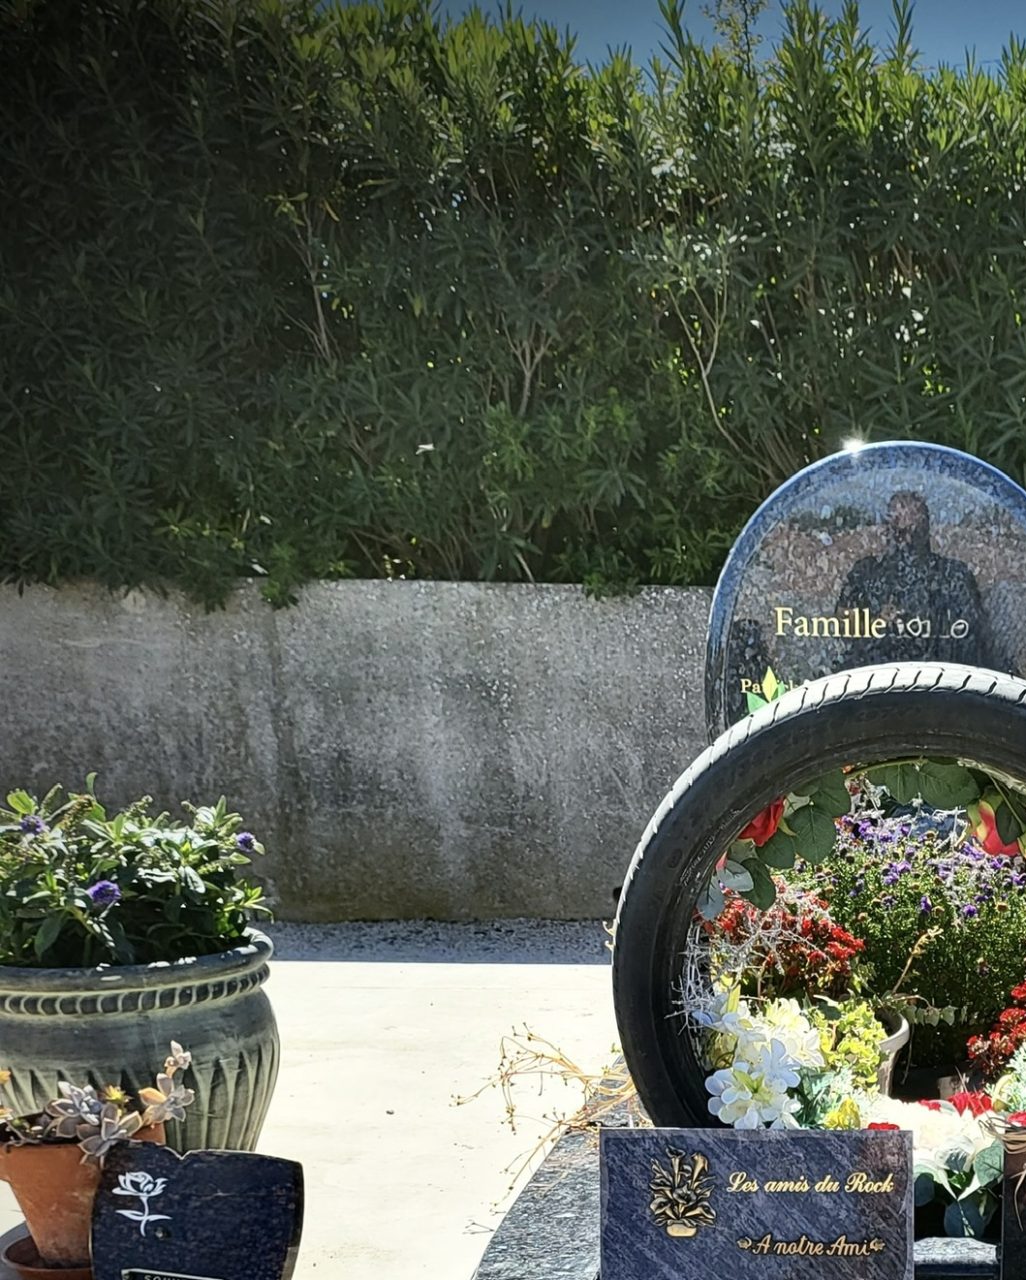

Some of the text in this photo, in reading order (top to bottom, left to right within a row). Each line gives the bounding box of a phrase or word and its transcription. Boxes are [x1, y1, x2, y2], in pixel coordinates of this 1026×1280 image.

[774, 607, 887, 638] Famille
[726, 1171, 894, 1194] Les amis du Rock
[753, 1233, 870, 1256] A notre Ami
